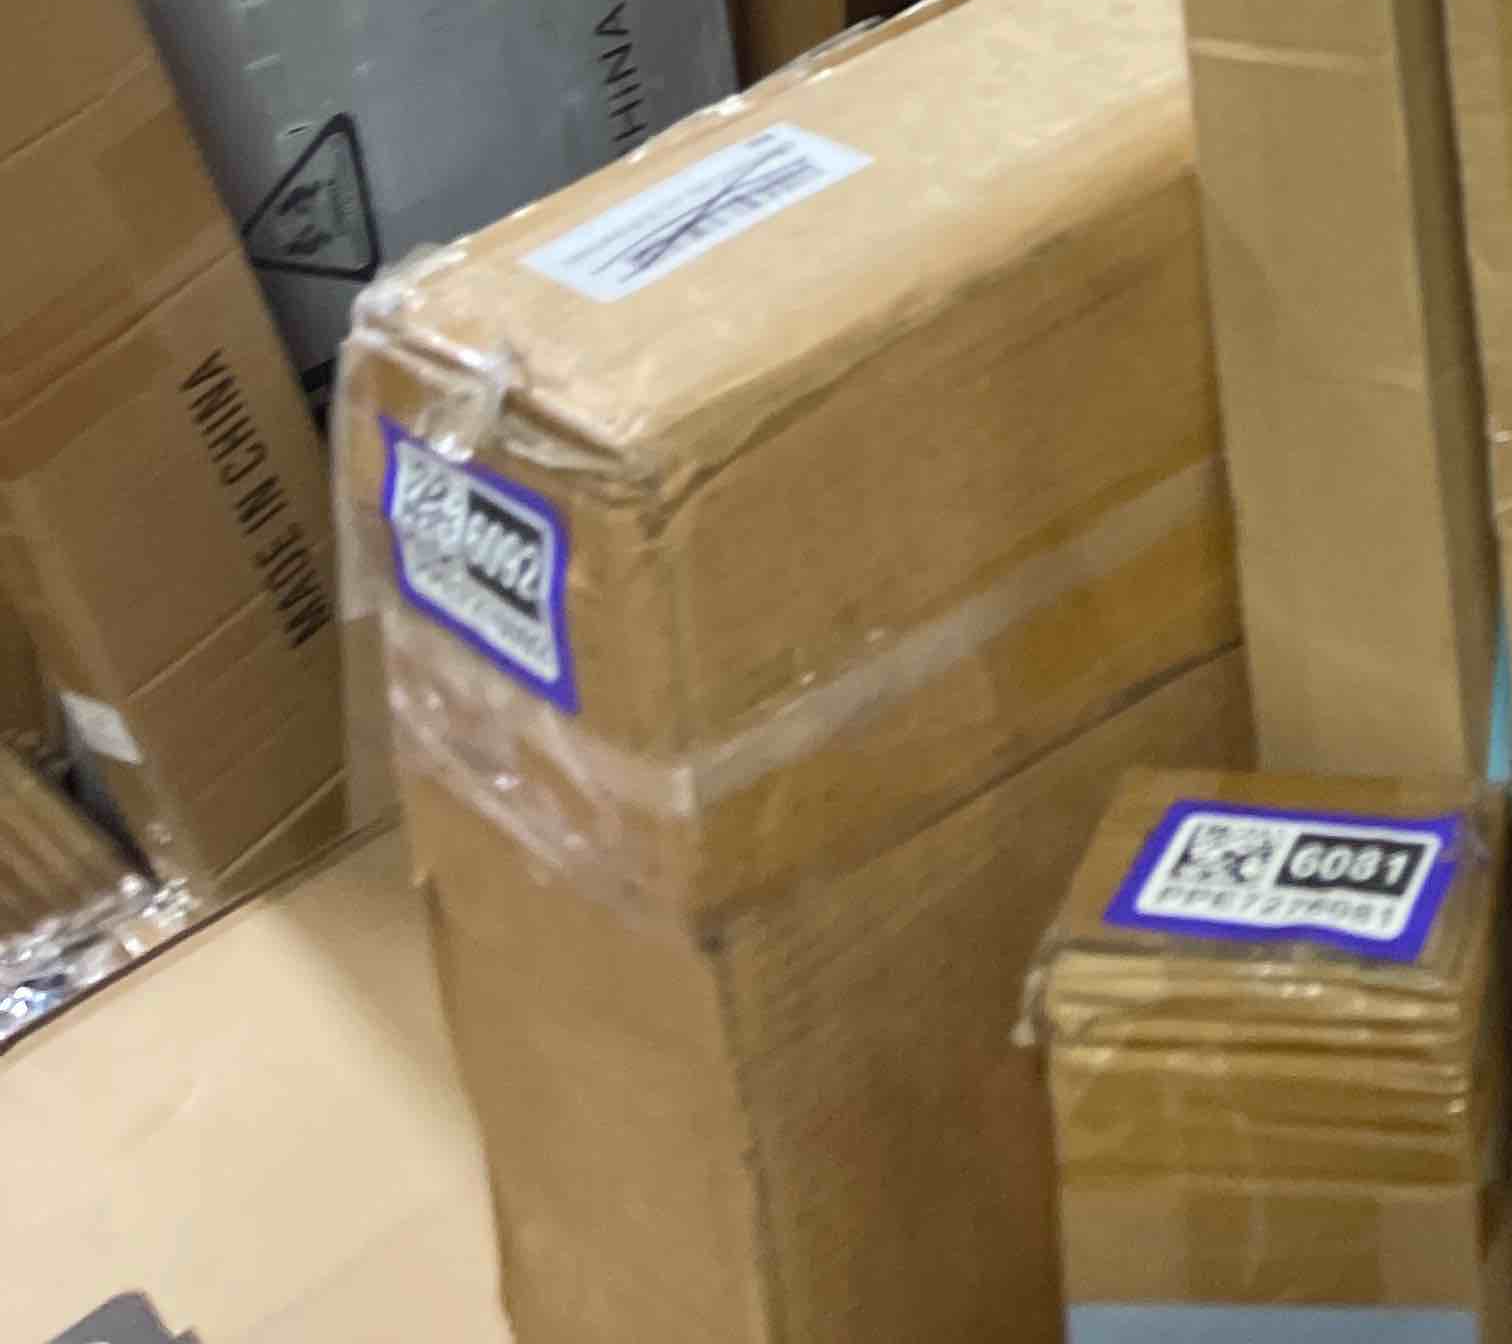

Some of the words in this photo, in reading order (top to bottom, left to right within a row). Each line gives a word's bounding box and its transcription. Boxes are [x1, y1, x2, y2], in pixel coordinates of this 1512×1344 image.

[595, 0, 649, 158] HINA
[178, 346, 271, 488] CHINA
[1289, 841, 1414, 887] 6081
